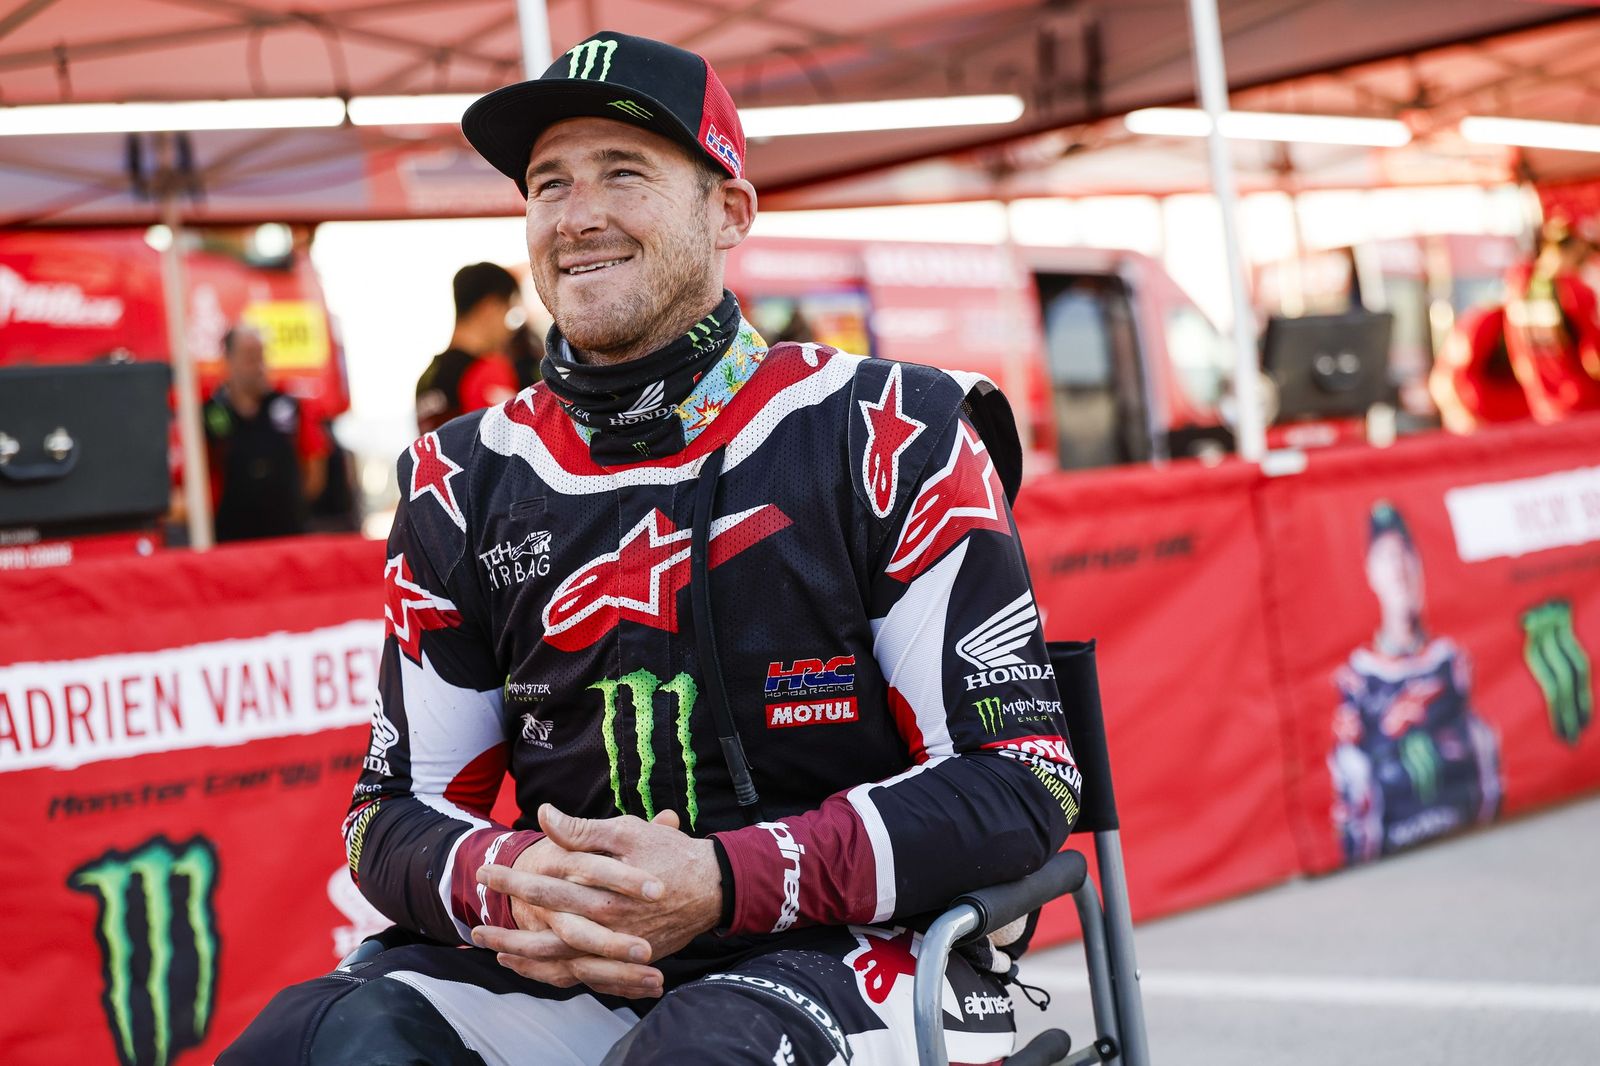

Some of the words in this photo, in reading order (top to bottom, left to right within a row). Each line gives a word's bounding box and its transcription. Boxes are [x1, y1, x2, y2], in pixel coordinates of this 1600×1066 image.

[608, 403, 680, 426] HONDA
[764, 654, 856, 692] HRC
[963, 664, 1056, 691] HONDA
[809, 684, 855, 695] RACING
[0, 671, 183, 753] ADRIEN
[203, 659, 295, 727] VAN
[771, 701, 855, 725] MOTUL
[1002, 698, 1063, 715] MONSTER
[704, 973, 850, 1061] HONDA
